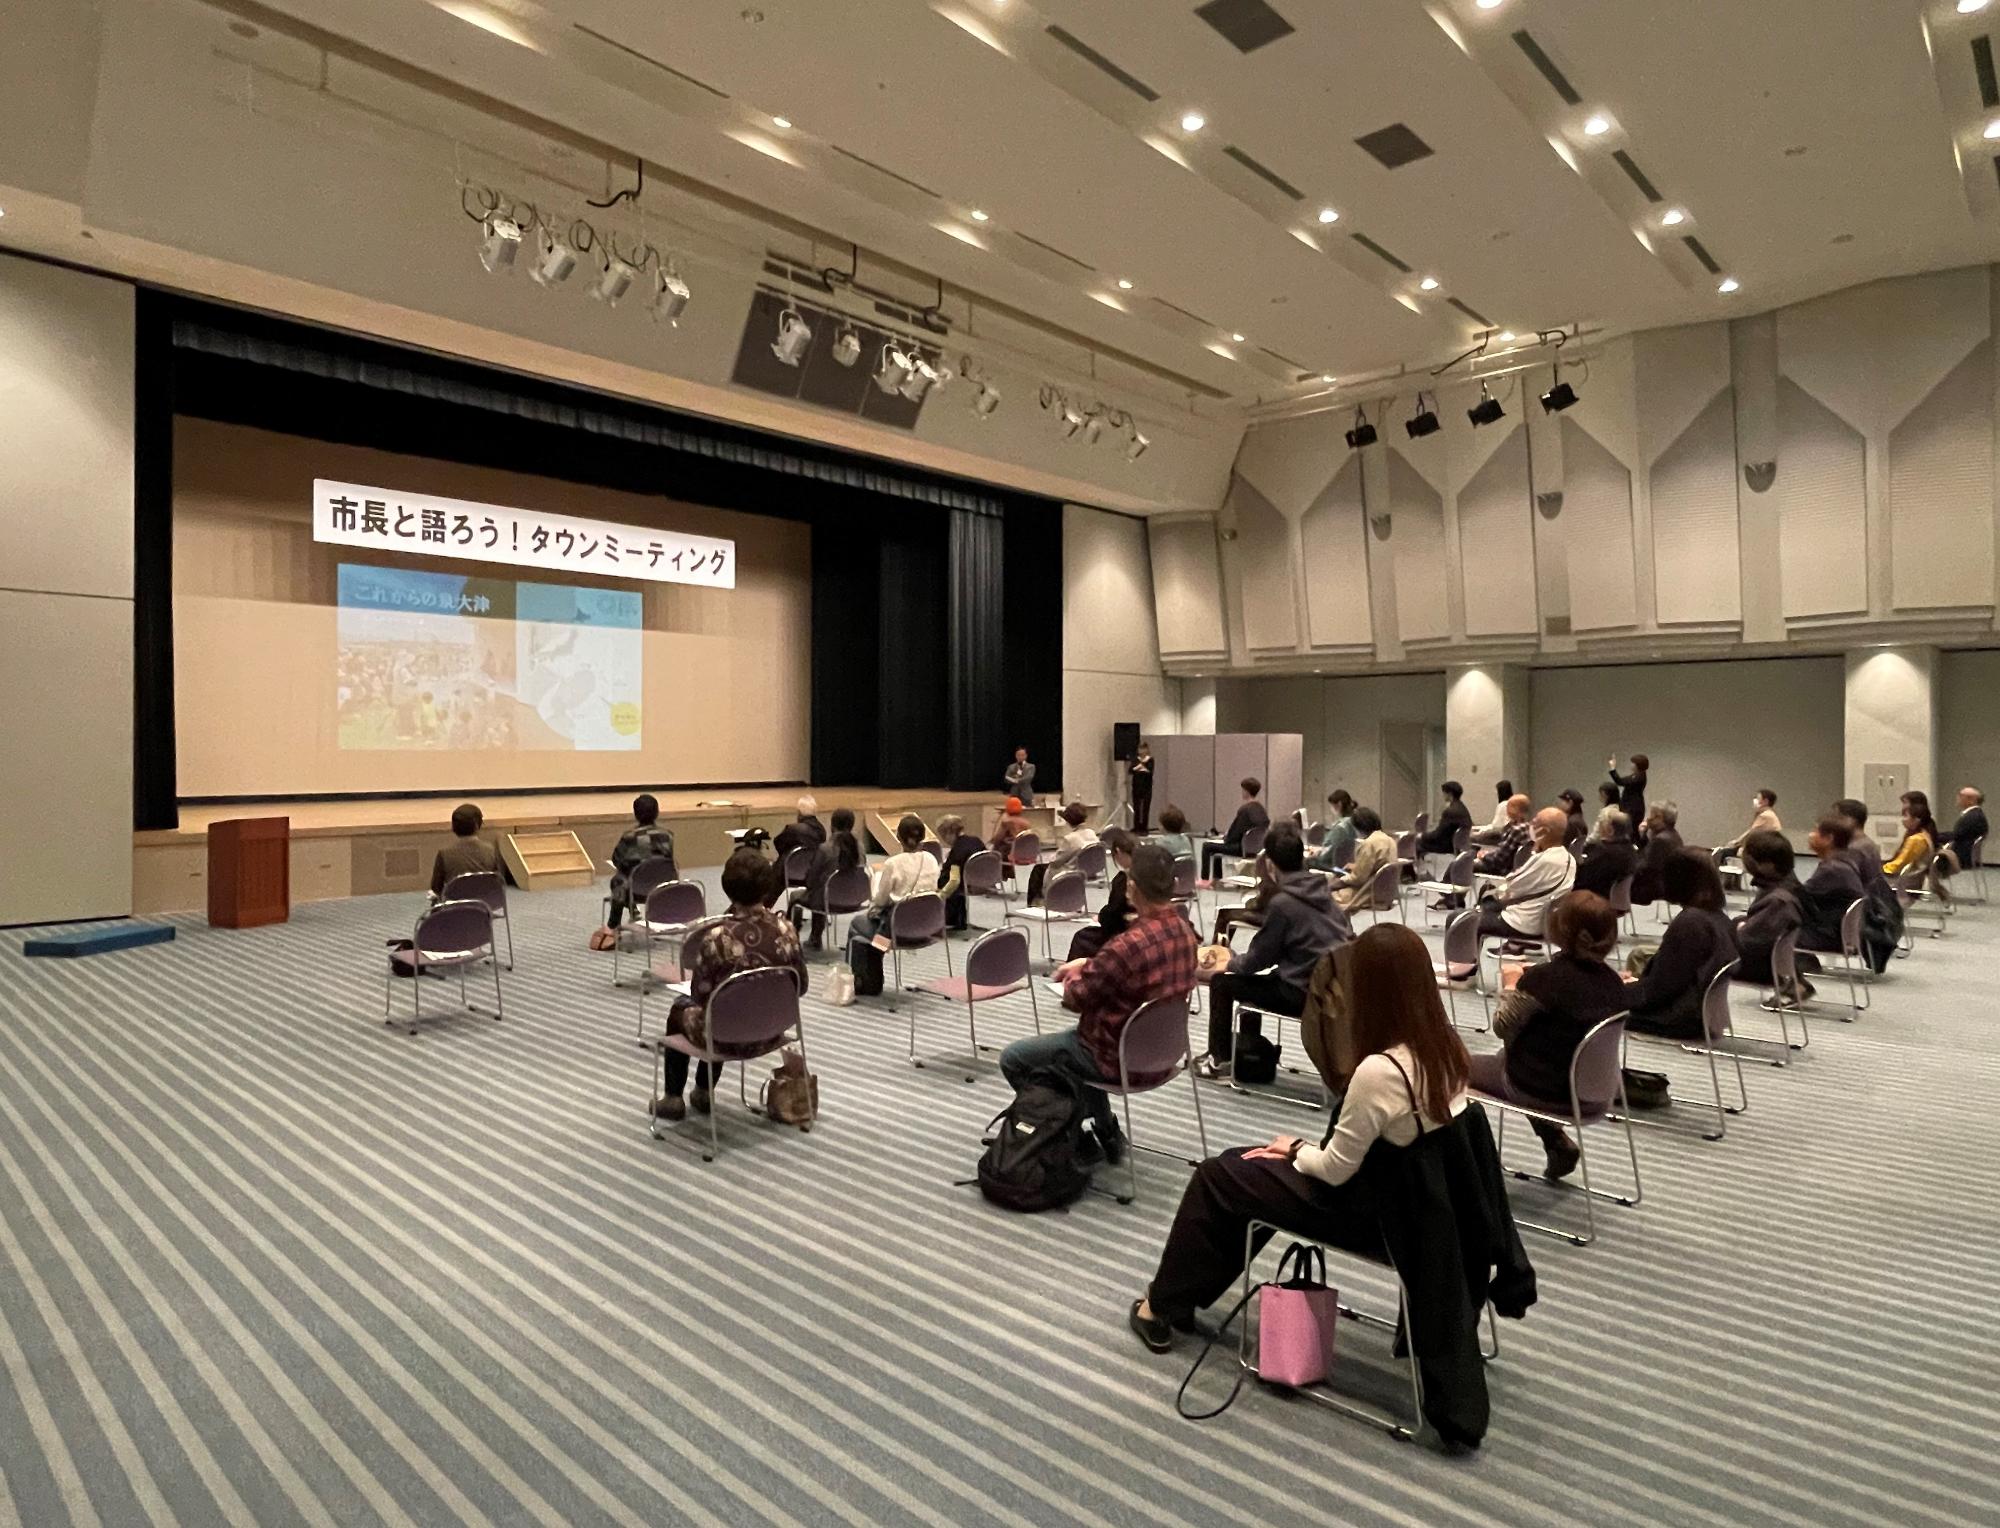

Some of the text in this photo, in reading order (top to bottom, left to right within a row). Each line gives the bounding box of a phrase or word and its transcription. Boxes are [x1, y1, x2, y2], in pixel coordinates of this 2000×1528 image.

[329, 496, 726, 575] 市長と語ろう！タウンミーティング
